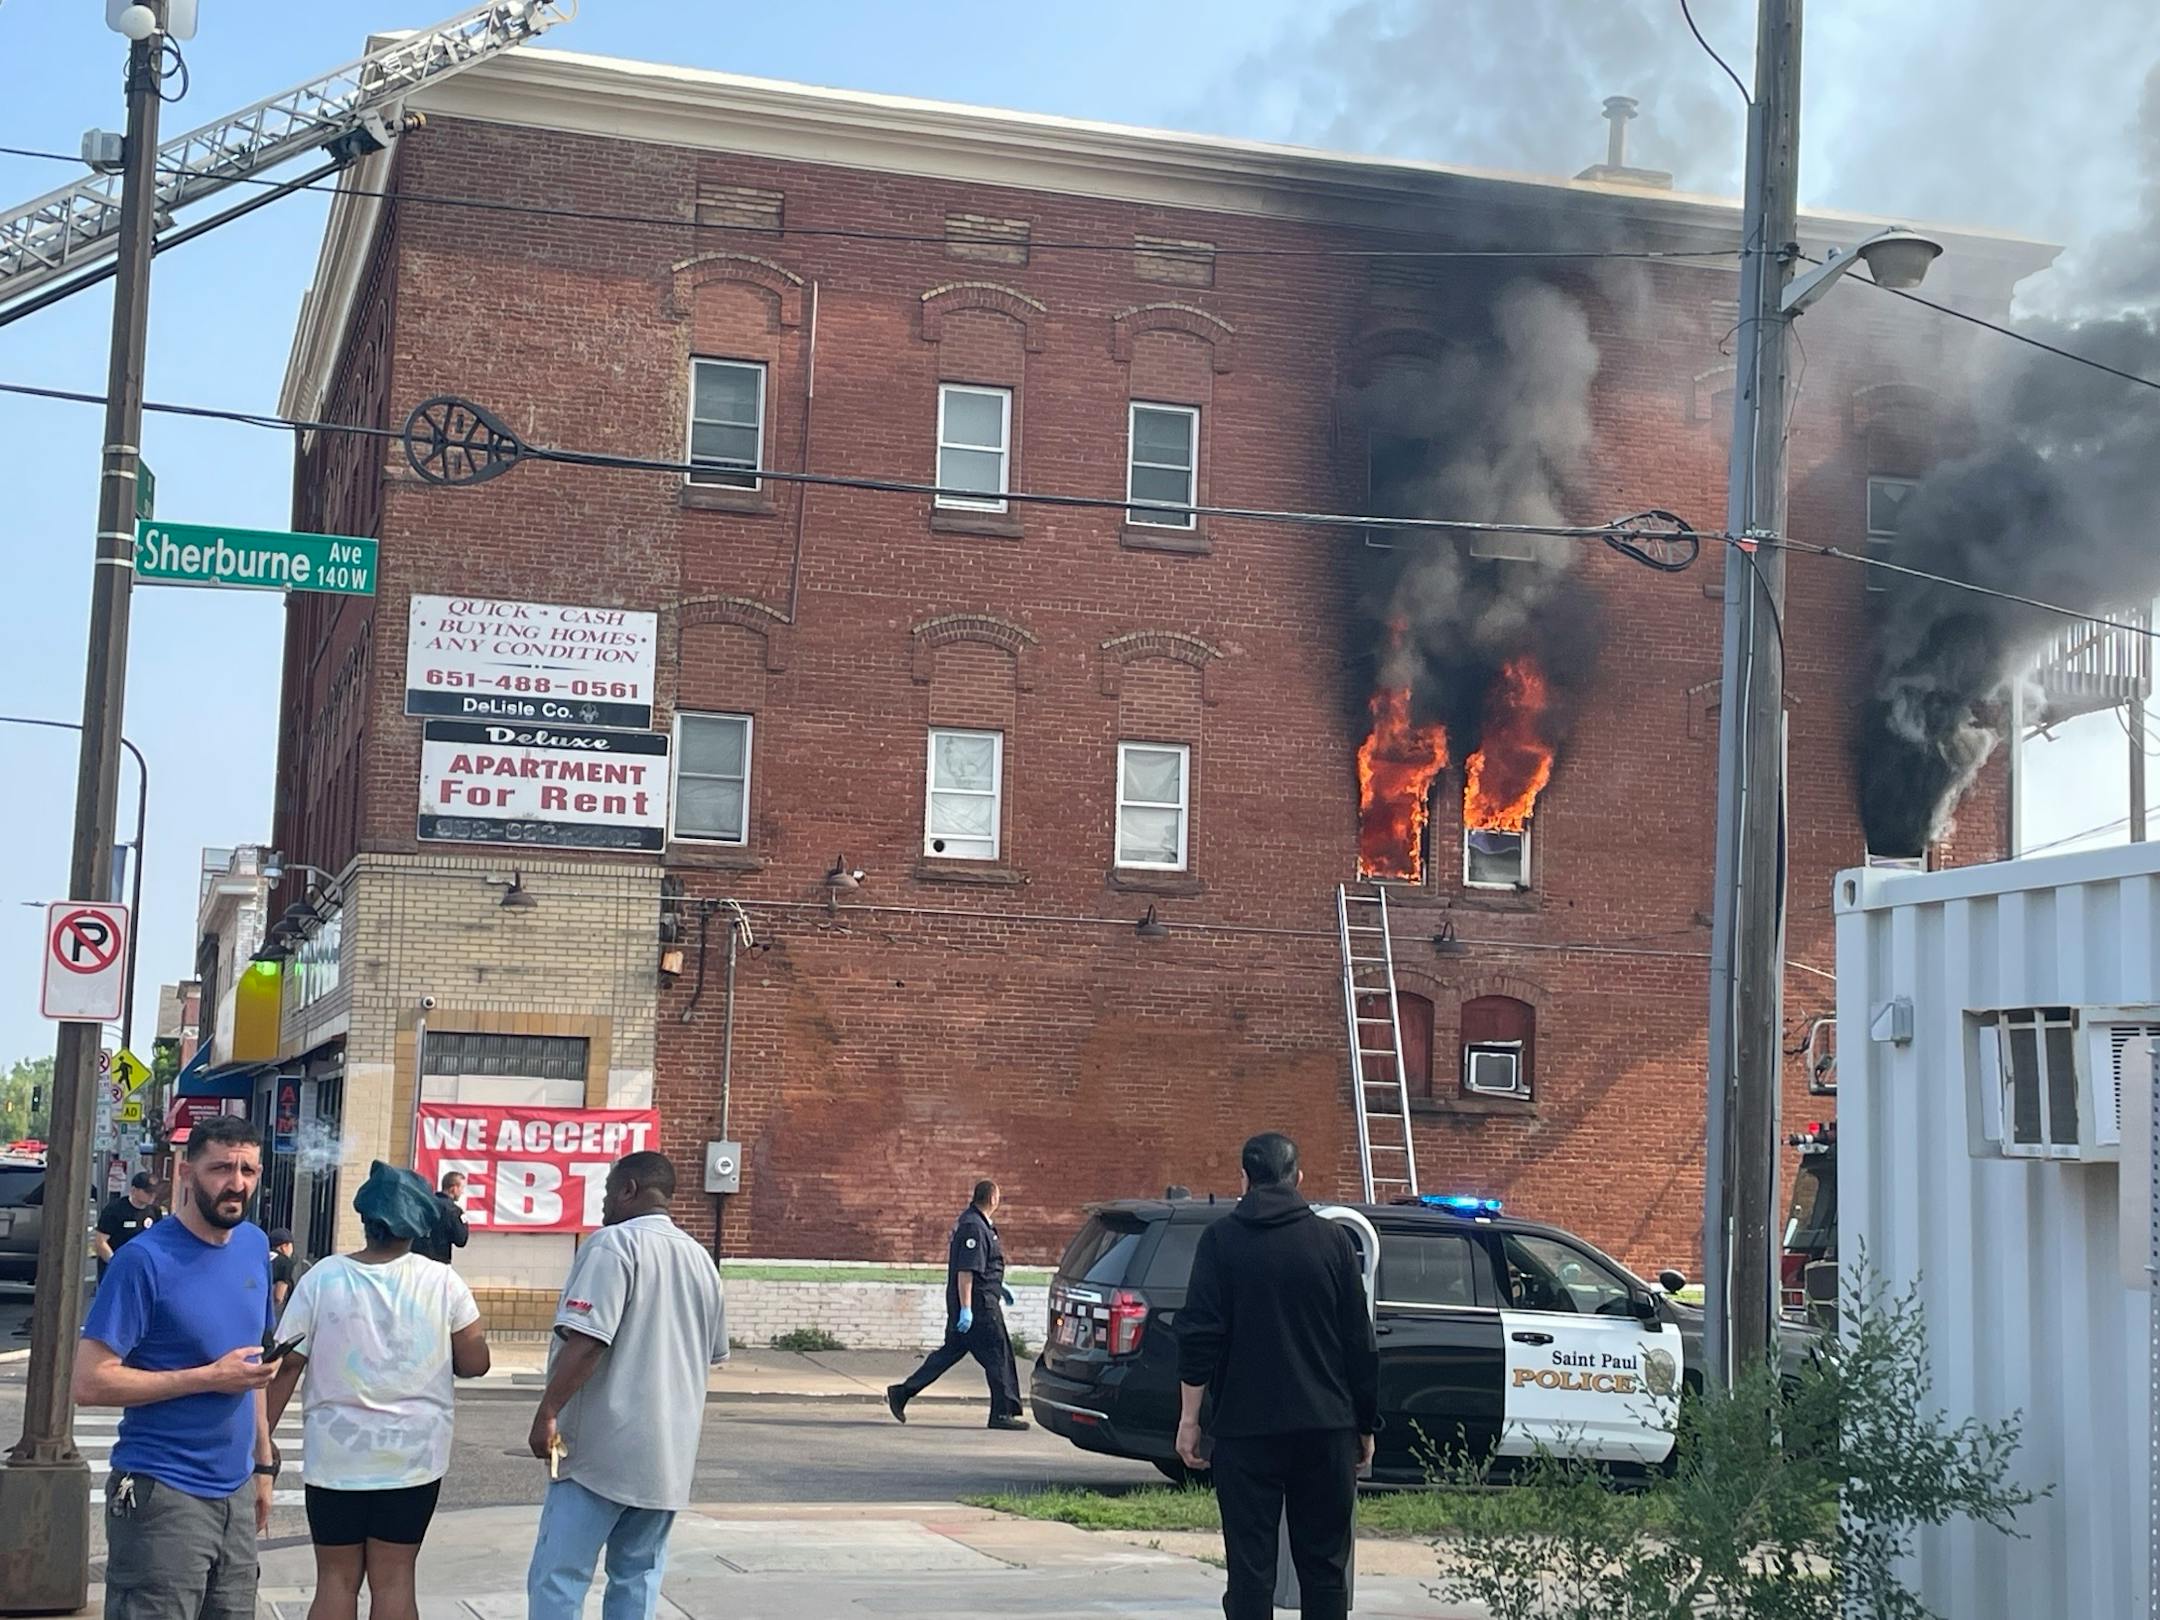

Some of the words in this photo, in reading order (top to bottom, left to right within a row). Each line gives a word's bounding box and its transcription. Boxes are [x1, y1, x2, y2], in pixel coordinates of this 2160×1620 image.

[143, 529, 310, 582] Sherburne
[329, 542, 361, 564] Ave
[448, 600, 530, 619] QUICK
[560, 609, 626, 626] CASH
[439, 619, 541, 639] BUYING
[550, 628, 637, 645] HOMES
[425, 637, 486, 652] ANY
[493, 642, 640, 663] CONDITION
[426, 669, 638, 698] 651-488-0561
[463, 698, 535, 716] DeLisle
[542, 702, 573, 718] Co.
[485, 727, 611, 750] Deluxe
[449, 754, 646, 785] APARTMENT
[440, 779, 515, 807] For
[540, 786, 648, 816] Rent
[423, 1116, 488, 1150] WE
[495, 1120, 652, 1154] ACCEPT
[437, 1159, 611, 1227] EBT
[1552, 1350, 1595, 1367] Saint
[1602, 1353, 1637, 1370] Paul
[1513, 1368, 1637, 1394] POLICE
